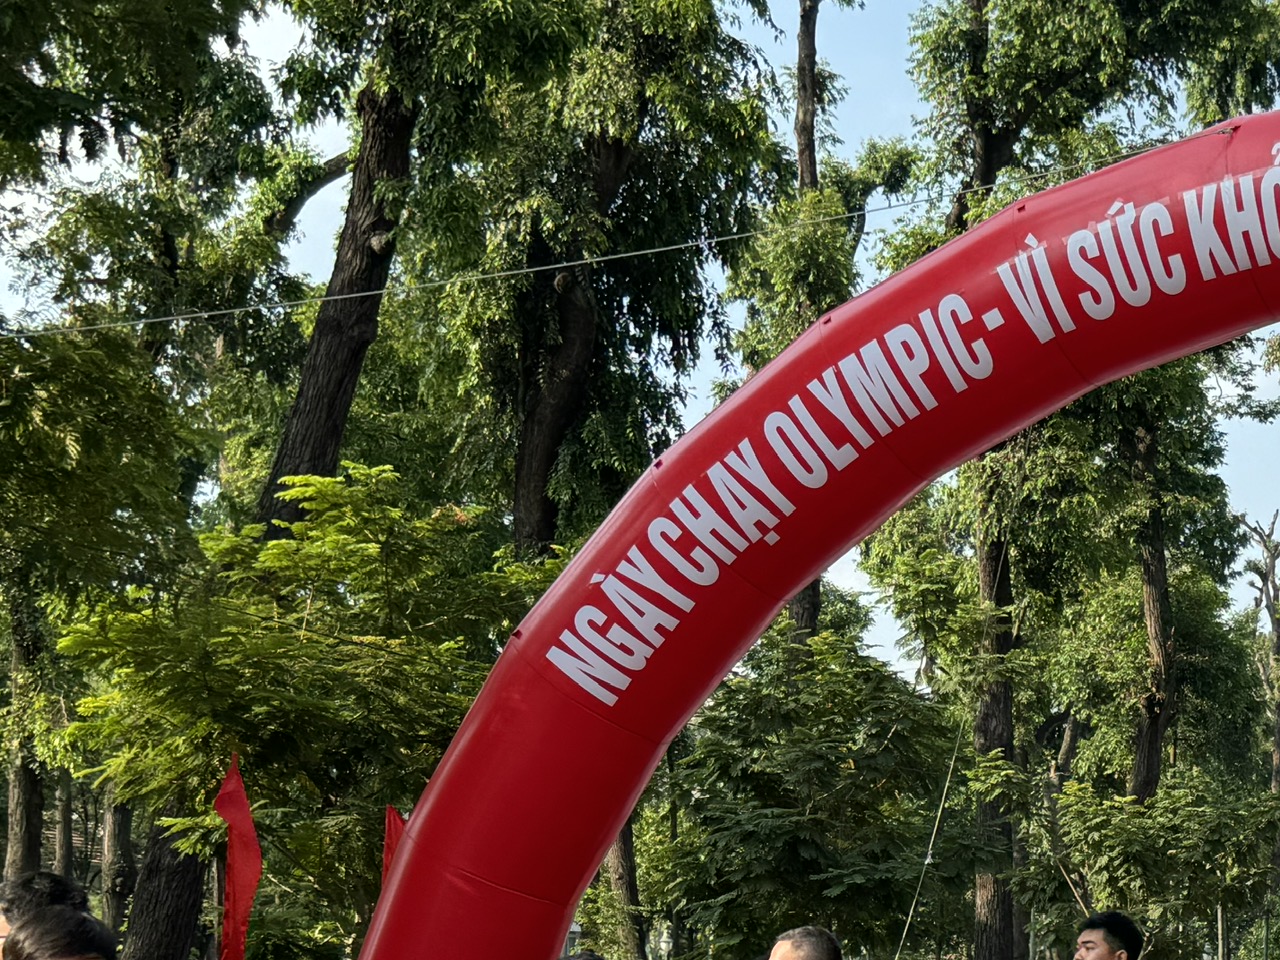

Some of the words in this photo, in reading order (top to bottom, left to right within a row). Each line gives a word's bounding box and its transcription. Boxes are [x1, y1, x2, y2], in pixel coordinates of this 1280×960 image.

[546, 545, 696, 707] NGÀY
[648, 437, 796, 586] CHẠY
[997, 232, 1077, 344] VÌ
[1067, 200, 1187, 320] SỨC
